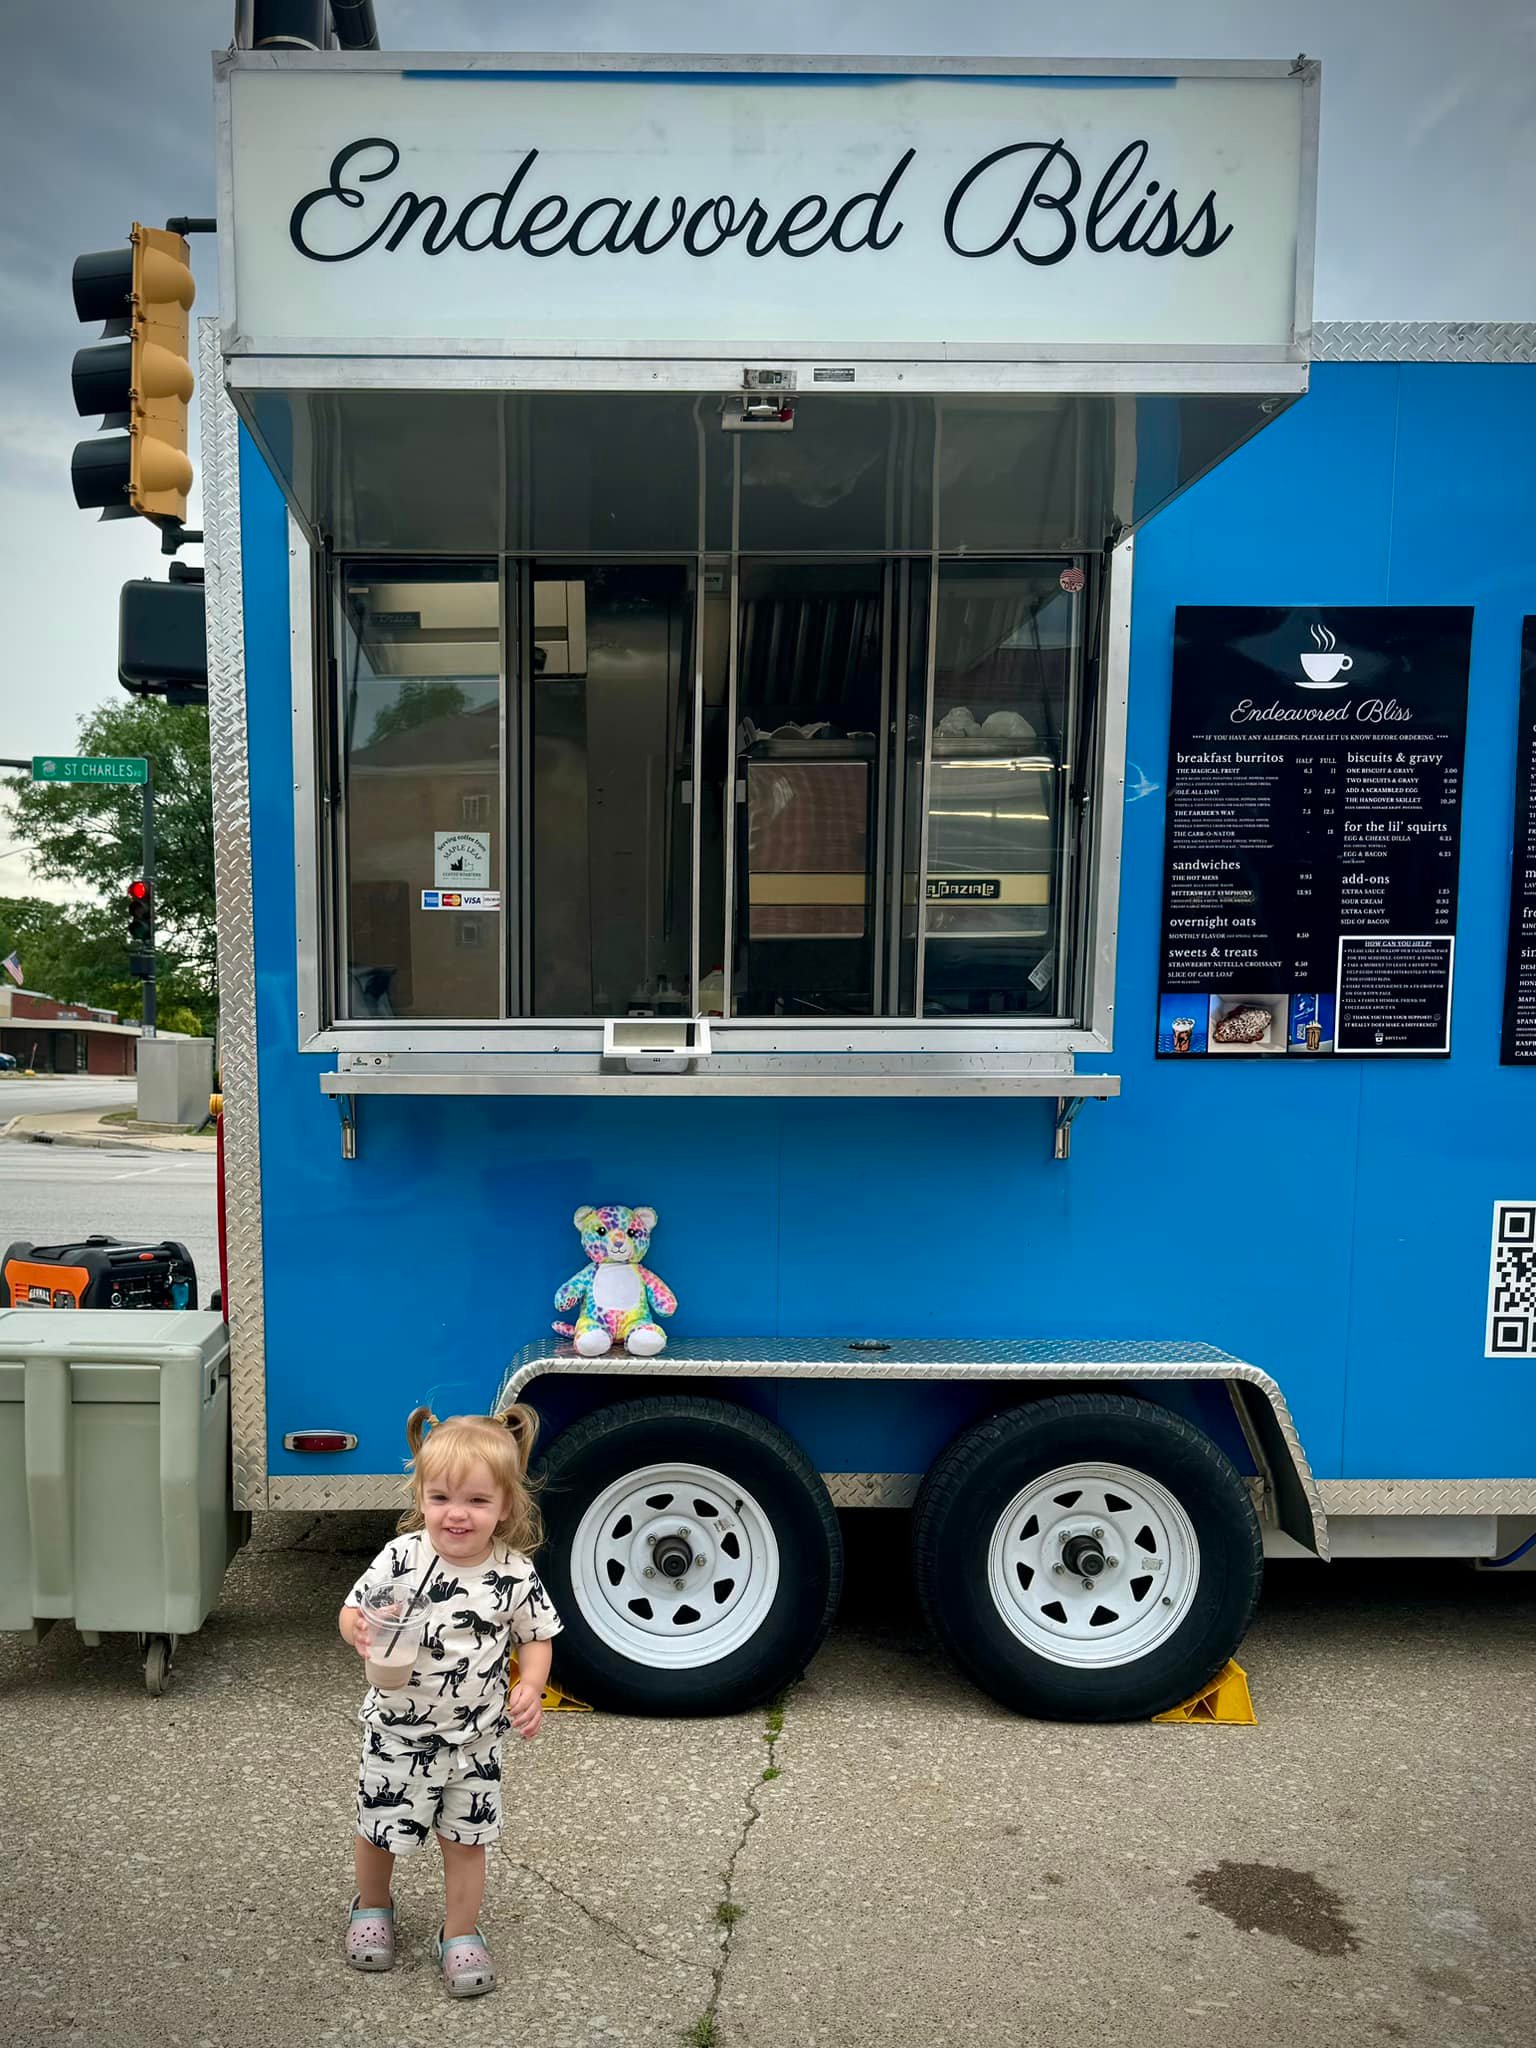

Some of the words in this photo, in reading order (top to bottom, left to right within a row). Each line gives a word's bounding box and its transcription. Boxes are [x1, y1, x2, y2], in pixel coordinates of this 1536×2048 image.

[290, 138, 916, 262] Endeavored
[944, 138, 1234, 265] Bliss
[1230, 699, 1350, 723] Endeavored
[1357, 699, 1413, 723] Bliss
[1177, 752, 1232, 764] breakfast
[1235, 752, 1285, 764] burritos
[1347, 752, 1393, 763] biscuits
[1396, 752, 1406, 763] &
[1409, 755, 1443, 766] gravy
[64, 764, 77, 776] ST
[81, 764, 134, 777] CHARLES
[1344, 821, 1363, 832] for
[1366, 821, 1385, 832] the
[1388, 821, 1404, 832] lil'
[1407, 821, 1448, 834] squirts
[457, 834, 475, 842] coffee
[443, 845, 466, 860] MAPLE
[467, 846, 482, 860] LEAF
[1172, 859, 1241, 870] sandwiches
[1342, 873, 1390, 884] add-ons
[1170, 916, 1228, 929] overnight
[1232, 918, 1257, 926] oats
[1168, 949, 1207, 957] sweets
[1210, 947, 1220, 957] &
[1224, 949, 1258, 957] treats
